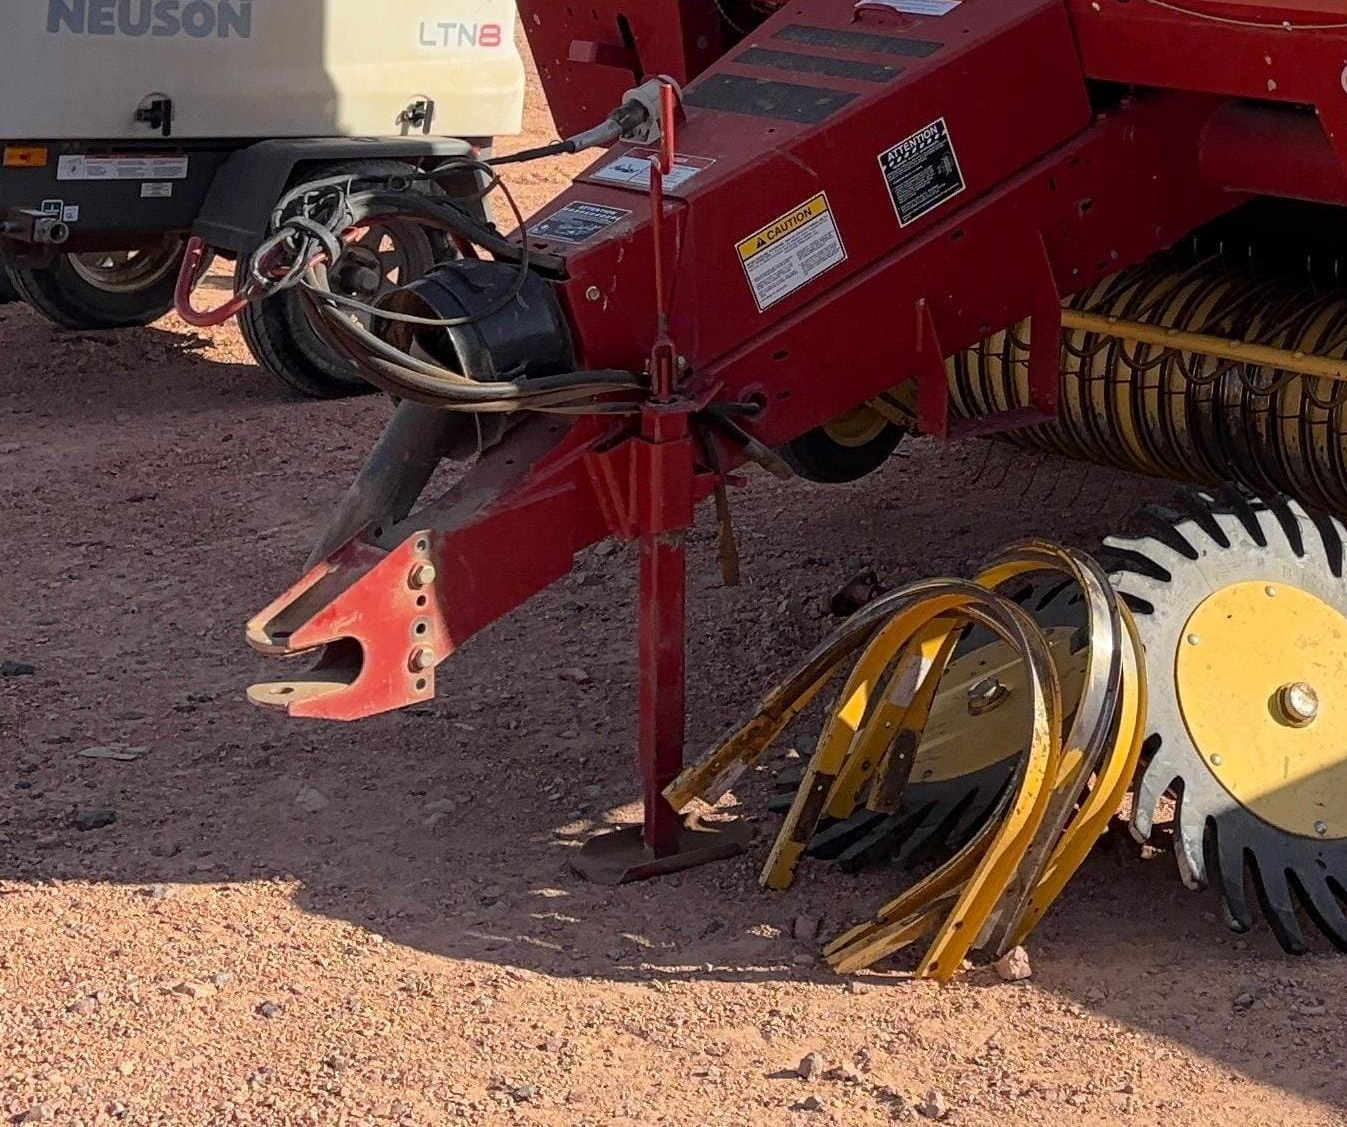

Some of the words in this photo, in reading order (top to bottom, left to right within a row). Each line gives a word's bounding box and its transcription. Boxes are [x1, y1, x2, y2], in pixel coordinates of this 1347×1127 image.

[419, 21, 501, 47] LTN8
[887, 125, 938, 162] ATTENTION
[767, 206, 813, 241] CAUTION
